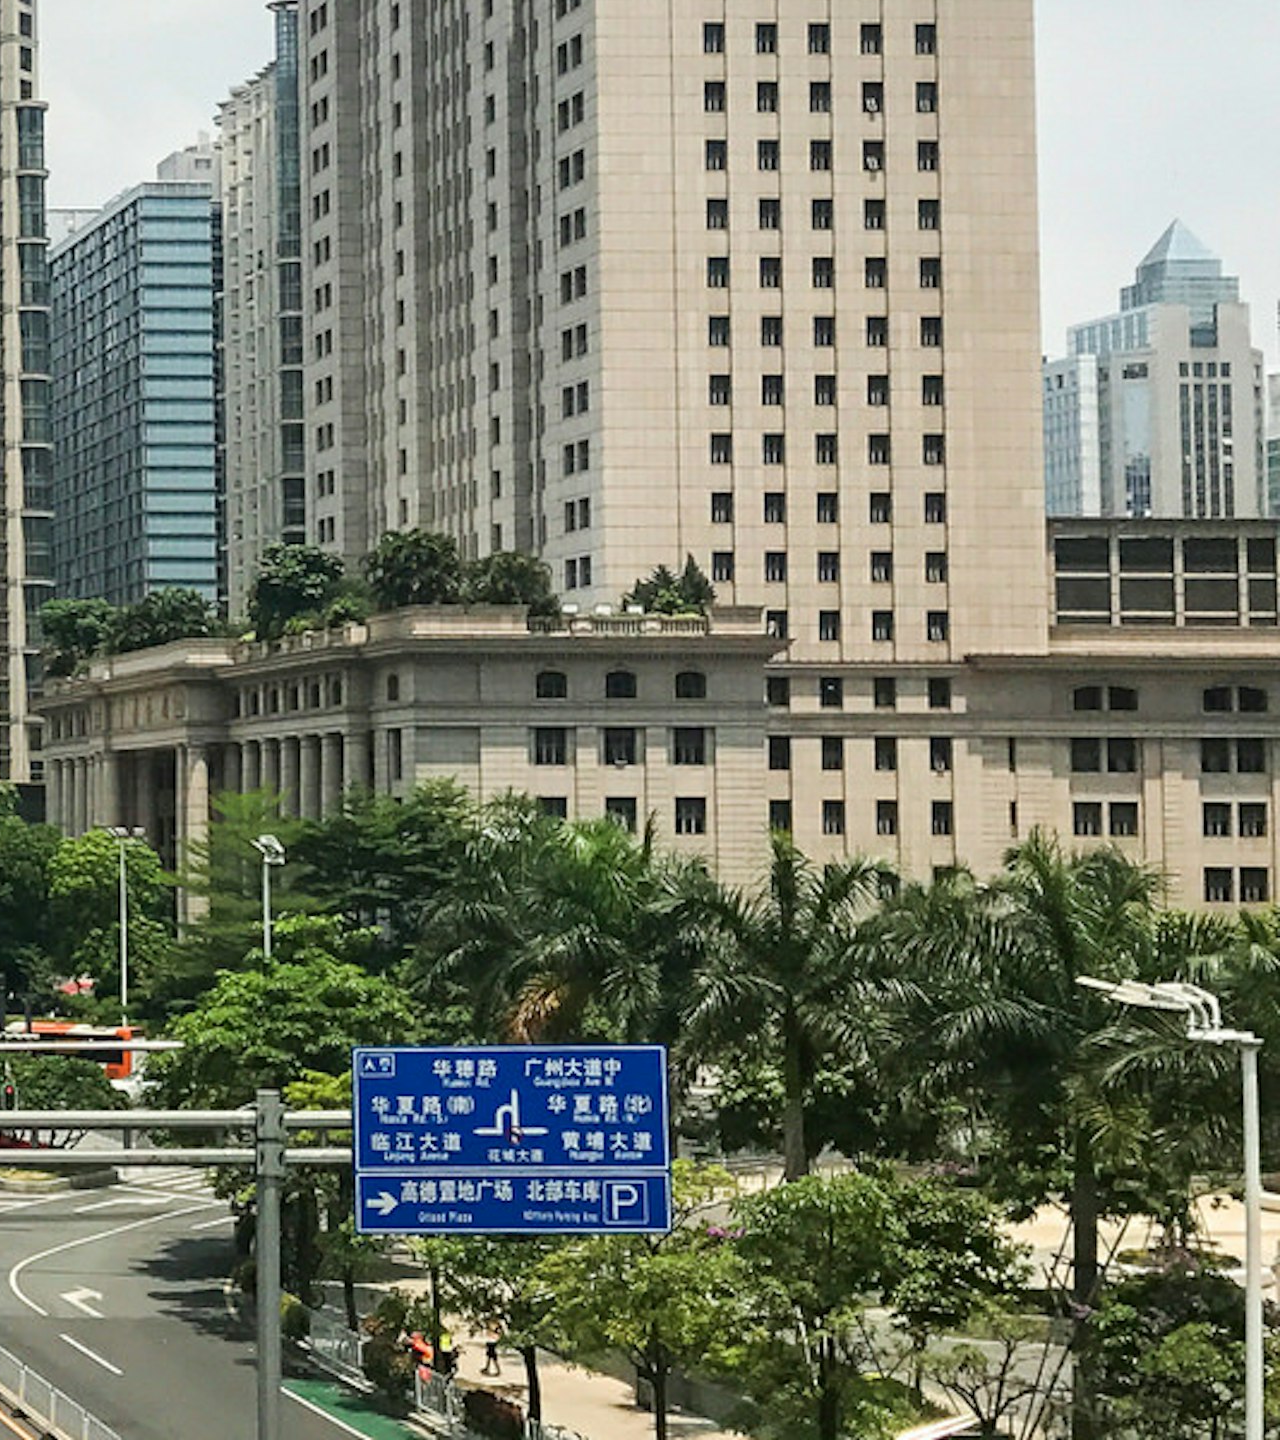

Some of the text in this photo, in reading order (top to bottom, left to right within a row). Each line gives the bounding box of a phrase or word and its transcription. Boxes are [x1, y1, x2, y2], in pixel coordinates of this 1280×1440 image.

[432, 1059, 497, 1078] 华穗路
[525, 1057, 622, 1077] 广州大道中
[371, 1132, 462, 1151] 临江大道
[561, 1131, 652, 1151] 黄埔大道
[400, 1179, 602, 1203] 高德置地广场 北部车库
